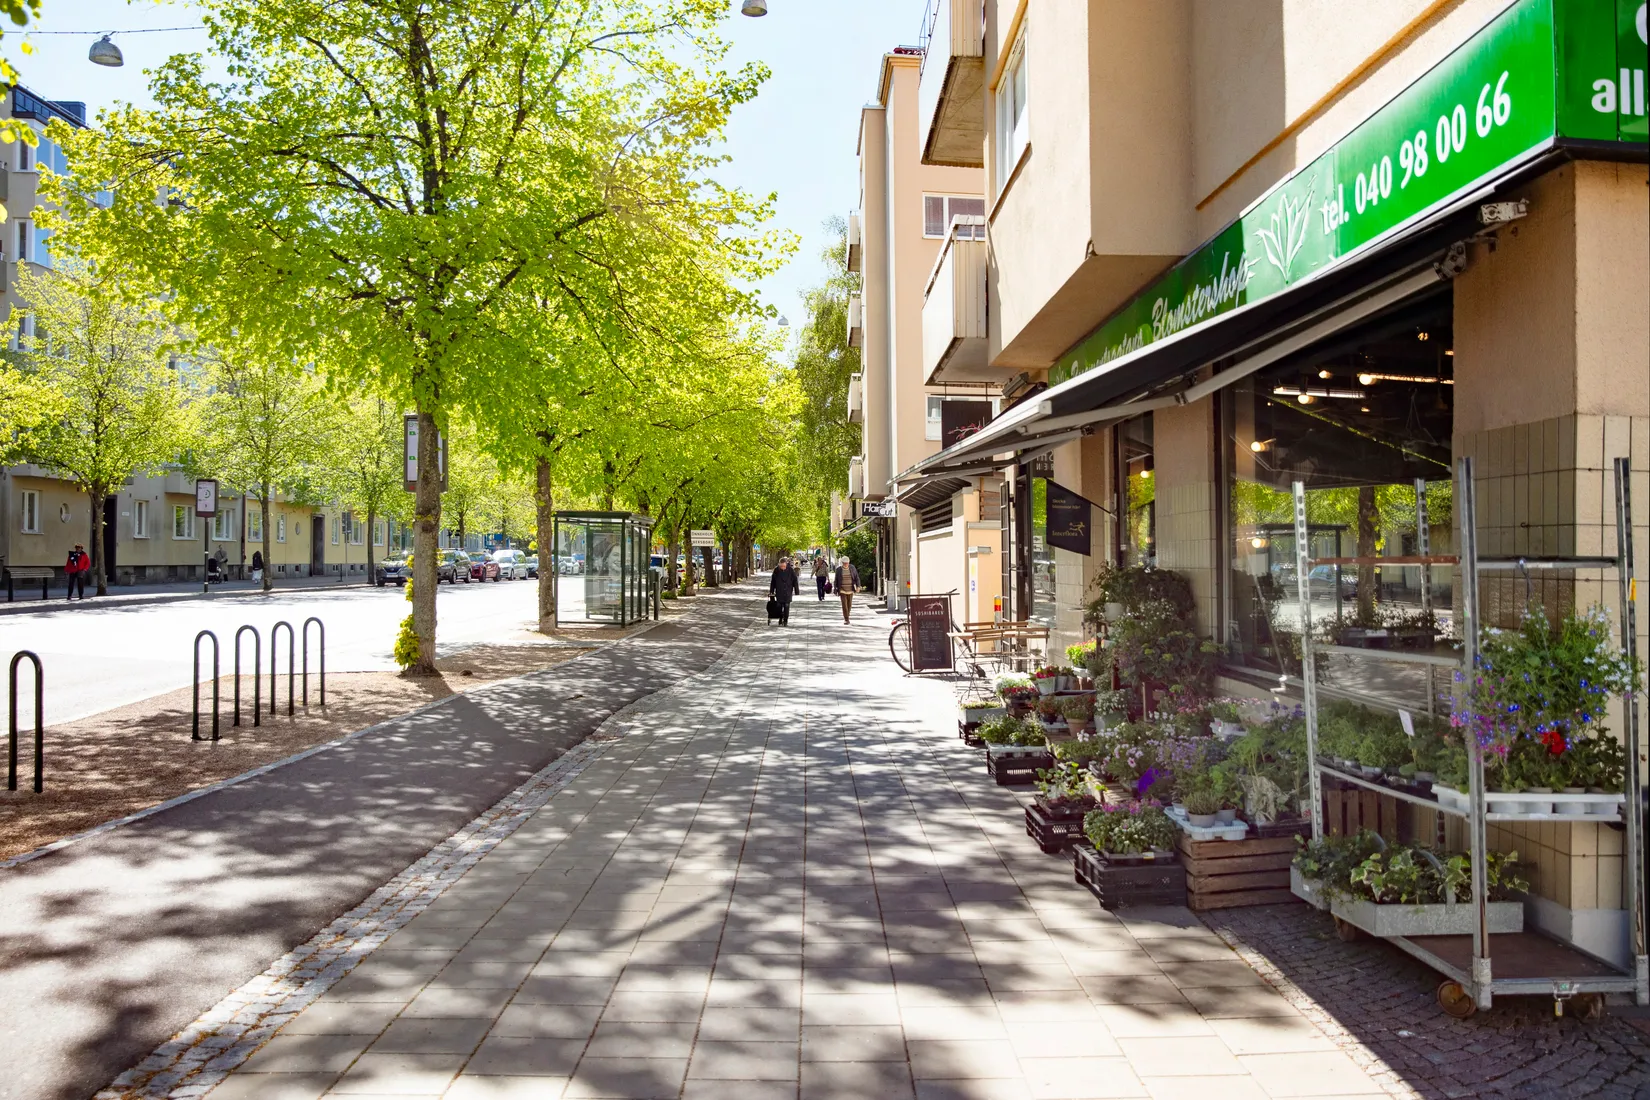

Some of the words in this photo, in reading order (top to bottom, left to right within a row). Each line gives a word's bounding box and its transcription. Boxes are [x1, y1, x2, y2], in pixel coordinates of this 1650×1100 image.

[1591, 67, 1649, 116] all
[1318, 183, 1350, 235] tel.
[1354, 155, 1393, 215] 040
[1399, 130, 1429, 190] 98
[1435, 104, 1468, 164] 00
[1475, 70, 1512, 138] 66
[1151, 251, 1250, 341] Blomstershop
[1051, 529, 1078, 537] Interflora
